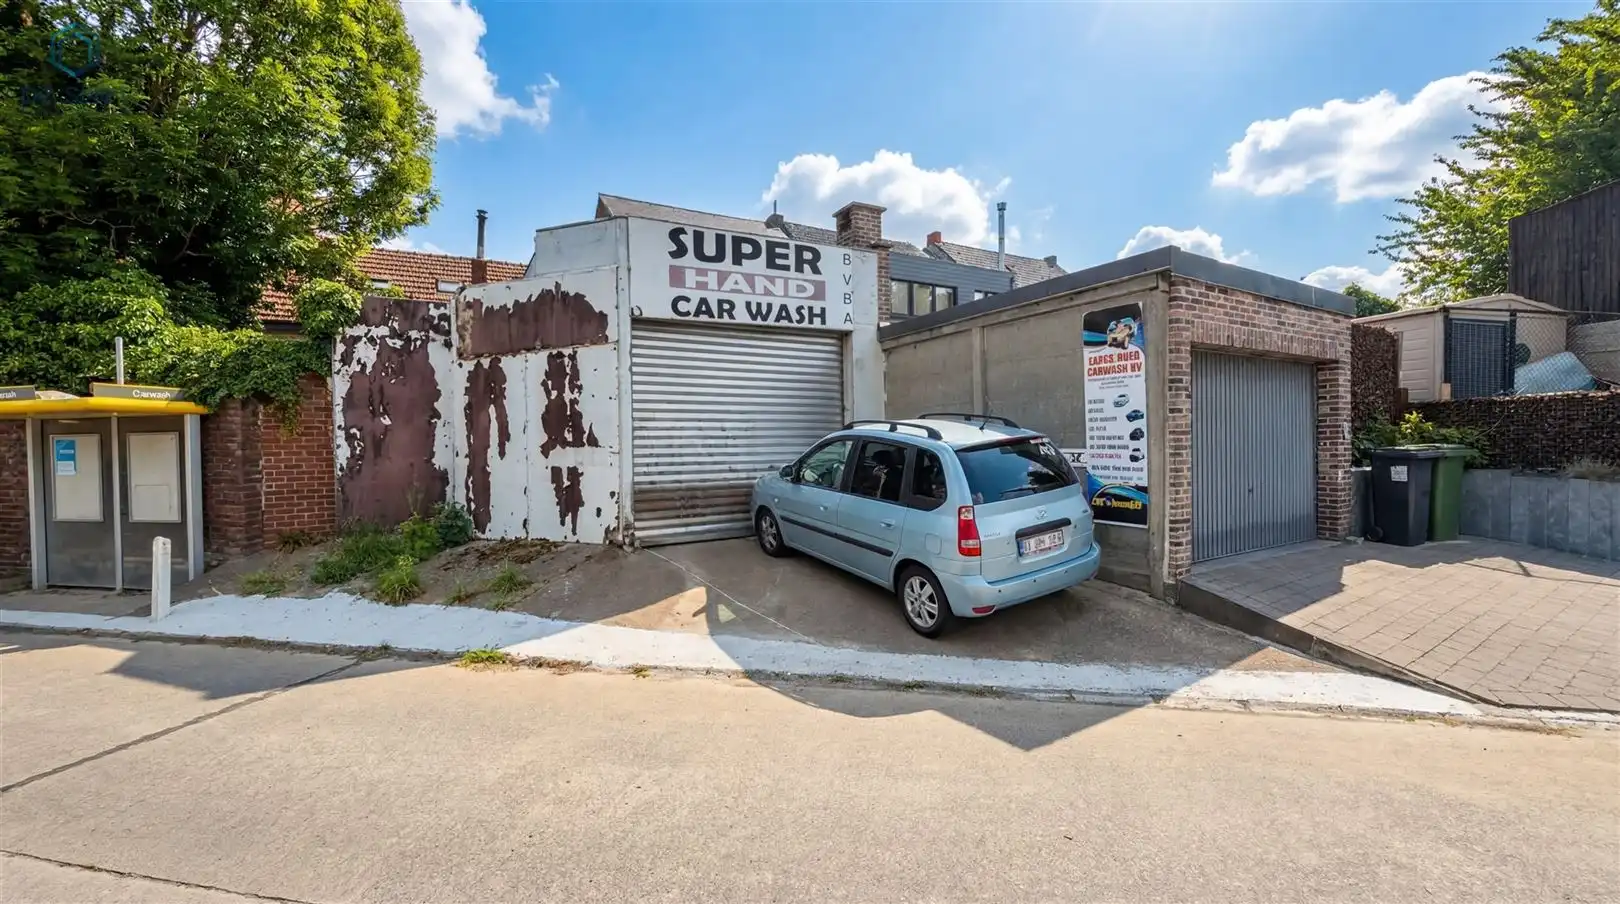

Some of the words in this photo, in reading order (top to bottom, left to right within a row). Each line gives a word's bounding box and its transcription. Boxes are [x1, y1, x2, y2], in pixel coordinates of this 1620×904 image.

[668, 227, 823, 276] SUPER
[684, 268, 816, 298] HAND
[670, 295, 736, 320] CAR
[745, 300, 827, 326] WASH
[1087, 363, 1128, 377] CARWASH
[132, 389, 171, 399] Carwash
